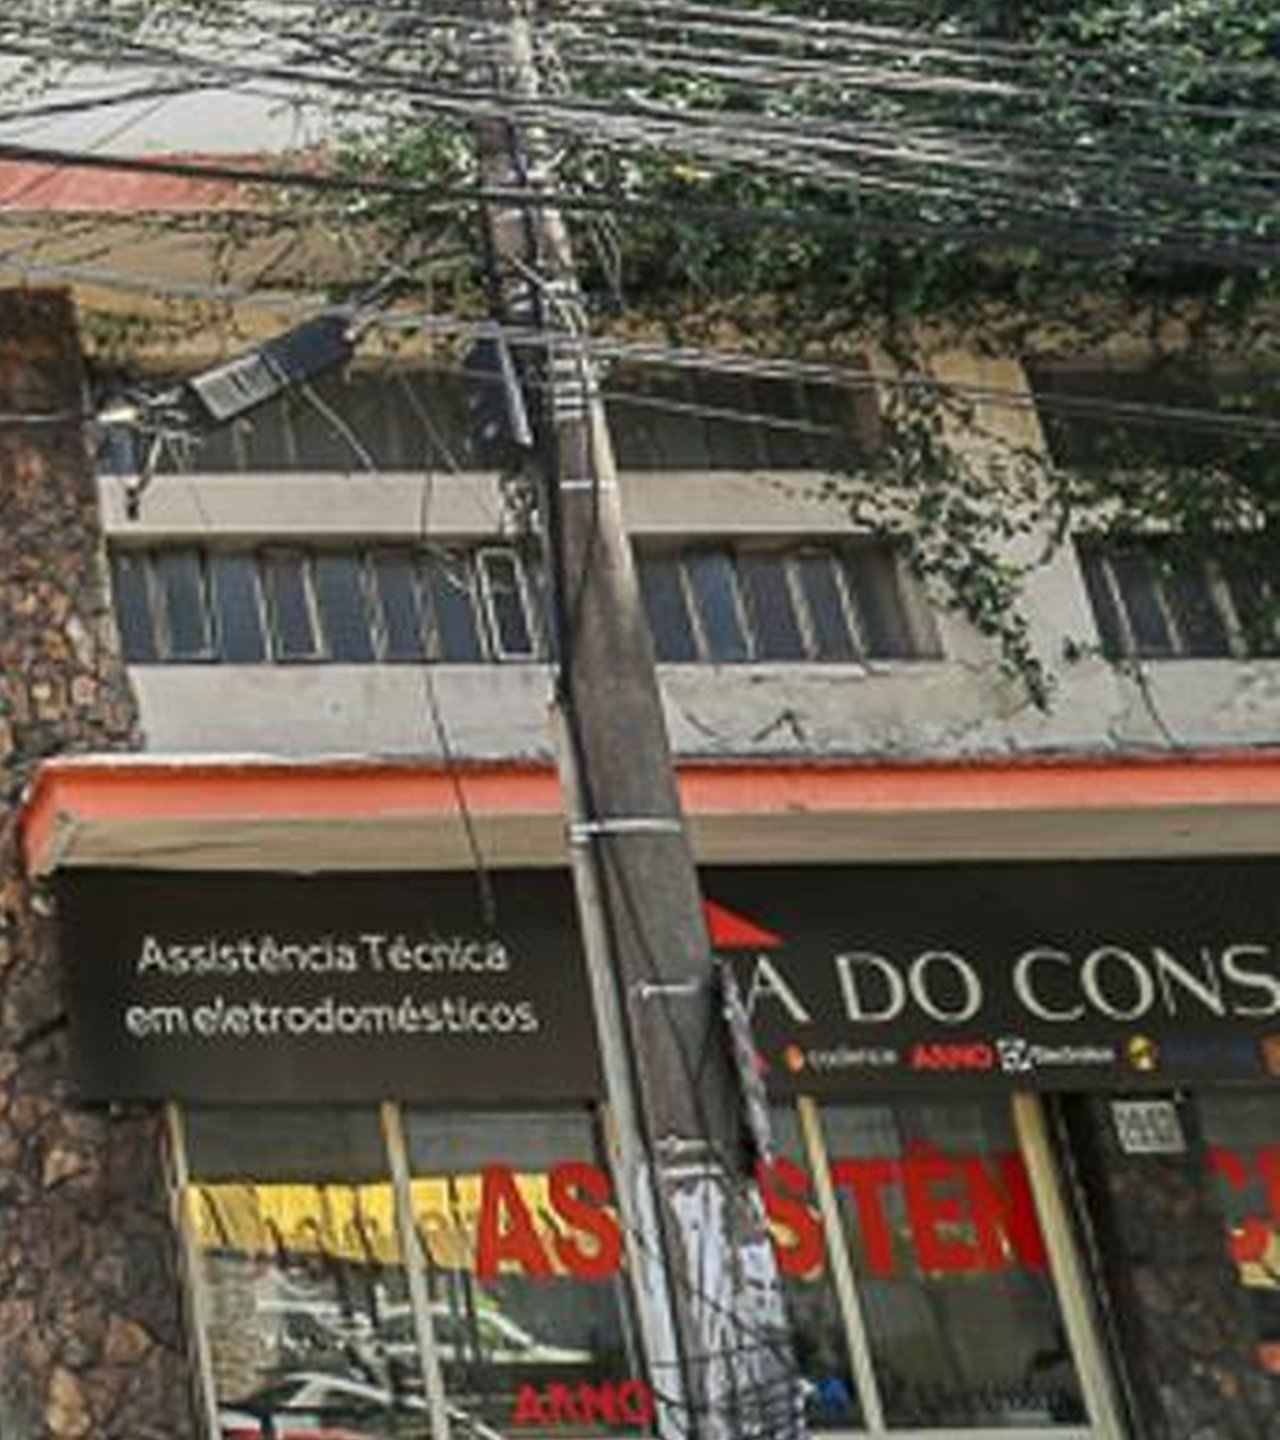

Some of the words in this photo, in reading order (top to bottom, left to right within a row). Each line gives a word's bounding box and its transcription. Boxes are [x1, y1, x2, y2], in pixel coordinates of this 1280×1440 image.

[139, 935, 357, 974] Assistência
[359, 934, 509, 973] Técnica
[836, 950, 983, 1022] DO
[125, 1005, 189, 1034] em
[192, 995, 539, 1035] eletrodomésticos
[514, 1380, 655, 1424] ARNO
